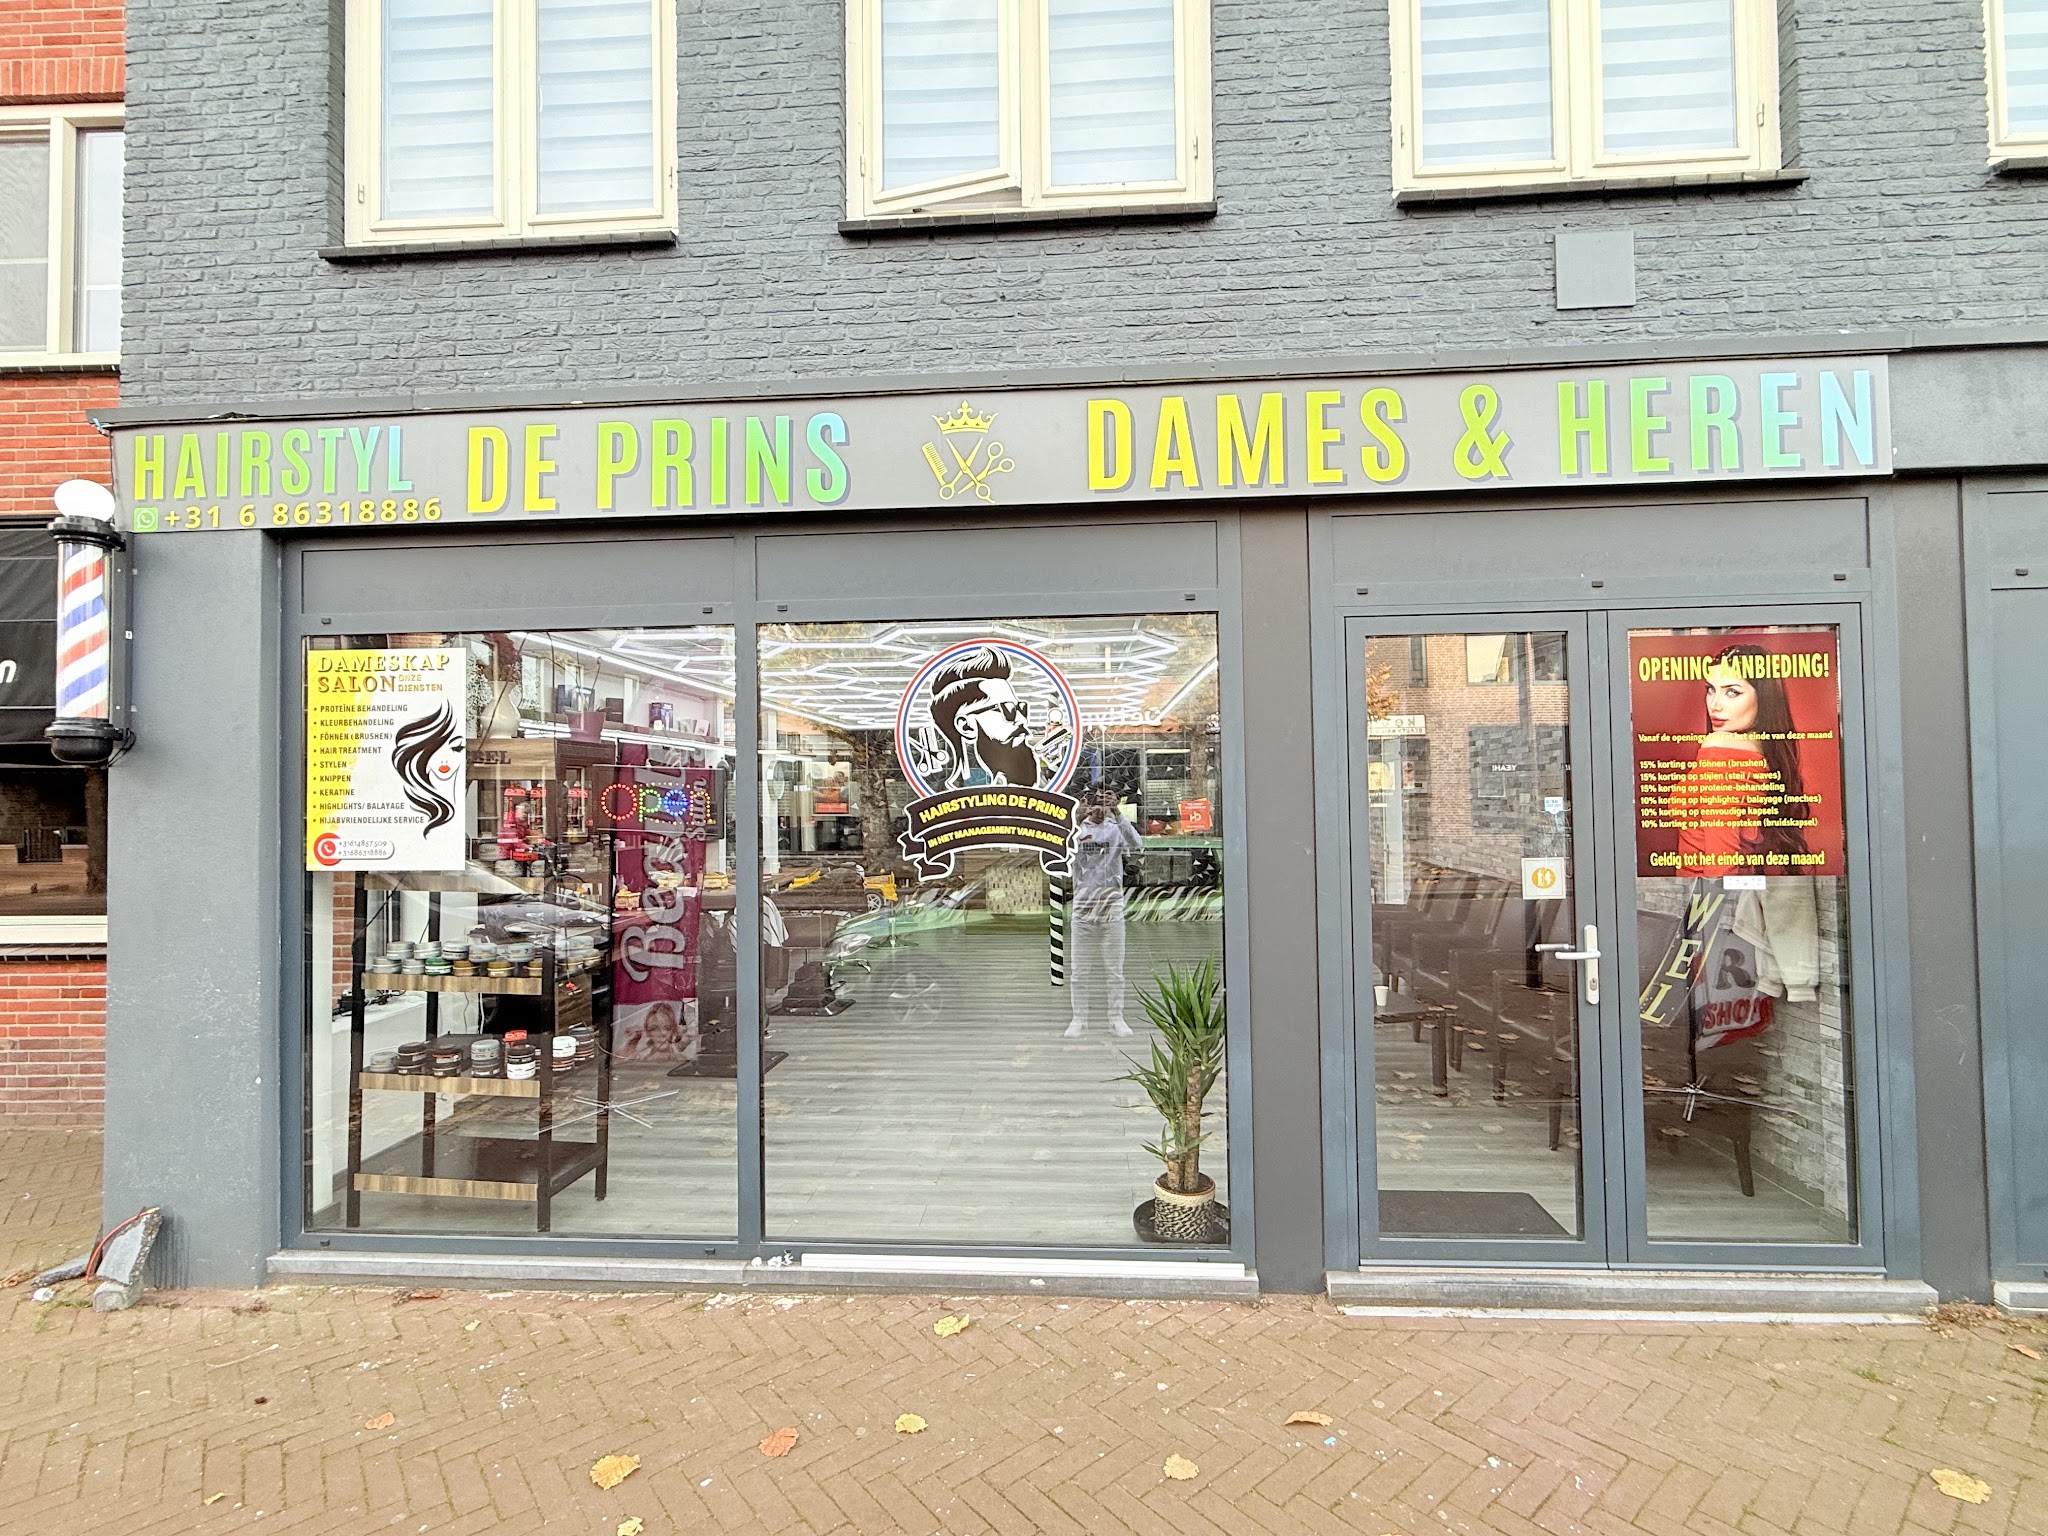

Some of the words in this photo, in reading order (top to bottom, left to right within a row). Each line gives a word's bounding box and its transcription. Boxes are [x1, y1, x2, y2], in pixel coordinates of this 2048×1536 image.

[1087, 388, 1408, 491] DAMES
[1453, 384, 1511, 481] &
[1557, 369, 1873, 476] HEREN
[134, 425, 414, 501] HAIRSTYL
[467, 424, 558, 514] DE
[597, 412, 849, 509] PRINS
[165, 505, 221, 529] +31
[239, 504, 256, 527] 6
[272, 498, 442, 526] 86318886
[318, 654, 450, 673] DAMESKAP
[1638, 655, 1715, 682] OPENING
[1720, 652, 1830, 679] AANBIEDING!
[318, 675, 397, 693] SALON
[399, 674, 422, 682] ONZE
[398, 683, 443, 692] DIENSTEN
[357, 704, 408, 712] BEHANDELING
[320, 718, 394, 727] KLEURBEHANDELING
[1638, 733, 1660, 742] Vanaf
[1661, 733, 1671, 742] de
[1748, 731, 1770, 741] einde
[1786, 731, 1806, 740] deze
[1806, 730, 1834, 739] maand
[319, 746, 337, 755] HAIR
[339, 746, 382, 754] TREATMENT
[319, 760, 347, 769] STYLEN
[1640, 761, 1656, 769] 15%
[1657, 760, 1686, 770] korting
[1687, 762, 1698, 770] op
[1699, 760, 1727, 768] föhnen
[1728, 759, 1767, 768] (brushen)
[319, 774, 352, 783] KNIPPEN
[1640, 773, 1656, 782] 15%
[1657, 773, 1687, 782] korting
[1687, 774, 1699, 782] op
[1725, 772, 1746, 781] (steil
[1752, 770, 1781, 781] waves)
[319, 788, 355, 797] KERATINE
[1640, 785, 1657, 793] 15%
[1658, 784, 1687, 794] korting
[1687, 786, 1699, 794] op
[366, 802, 405, 810] BALAYAGE
[1641, 797, 1657, 805] 10%
[1658, 796, 1687, 806] korting
[1688, 798, 1699, 806] op
[1700, 796, 1740, 806] highlights
[1746, 795, 1783, 805] balayage
[1783, 794, 1822, 805] (meches)
[918, 793, 1008, 824] HAIRSTYLING
[1008, 794, 1028, 809] DE
[1027, 797, 1068, 821] PRINS
[1641, 809, 1657, 817] 10%
[1658, 808, 1688, 818] korting
[1688, 809, 1700, 817] op
[1700, 807, 1747, 817] eenvoudige
[1747, 806, 1780, 816] kapsels
[319, 816, 392, 825] HIJABVRIENDELIJKE
[394, 816, 425, 824] SERVICE
[1641, 820, 1658, 829] 10%
[1659, 819, 1688, 831] korting
[1688, 821, 1699, 830] op
[1699, 818, 1762, 830] bruids-opsteken
[1763, 817, 1818, 829] (bruidskapsel)
[927, 838, 938, 848] IN
[937, 832, 954, 844] HET
[954, 825, 1017, 840] MANAGEMENT
[1016, 826, 1036, 838] VAN
[1035, 829, 1065, 846] SADEK
[1650, 852, 1682, 869] Geldig
[1684, 853, 1698, 866] tot
[1700, 852, 1716, 866] het
[1717, 852, 1745, 865] einde
[1746, 855, 1764, 865] van
[1766, 851, 1789, 865] deze
[1791, 850, 1825, 865] maand
